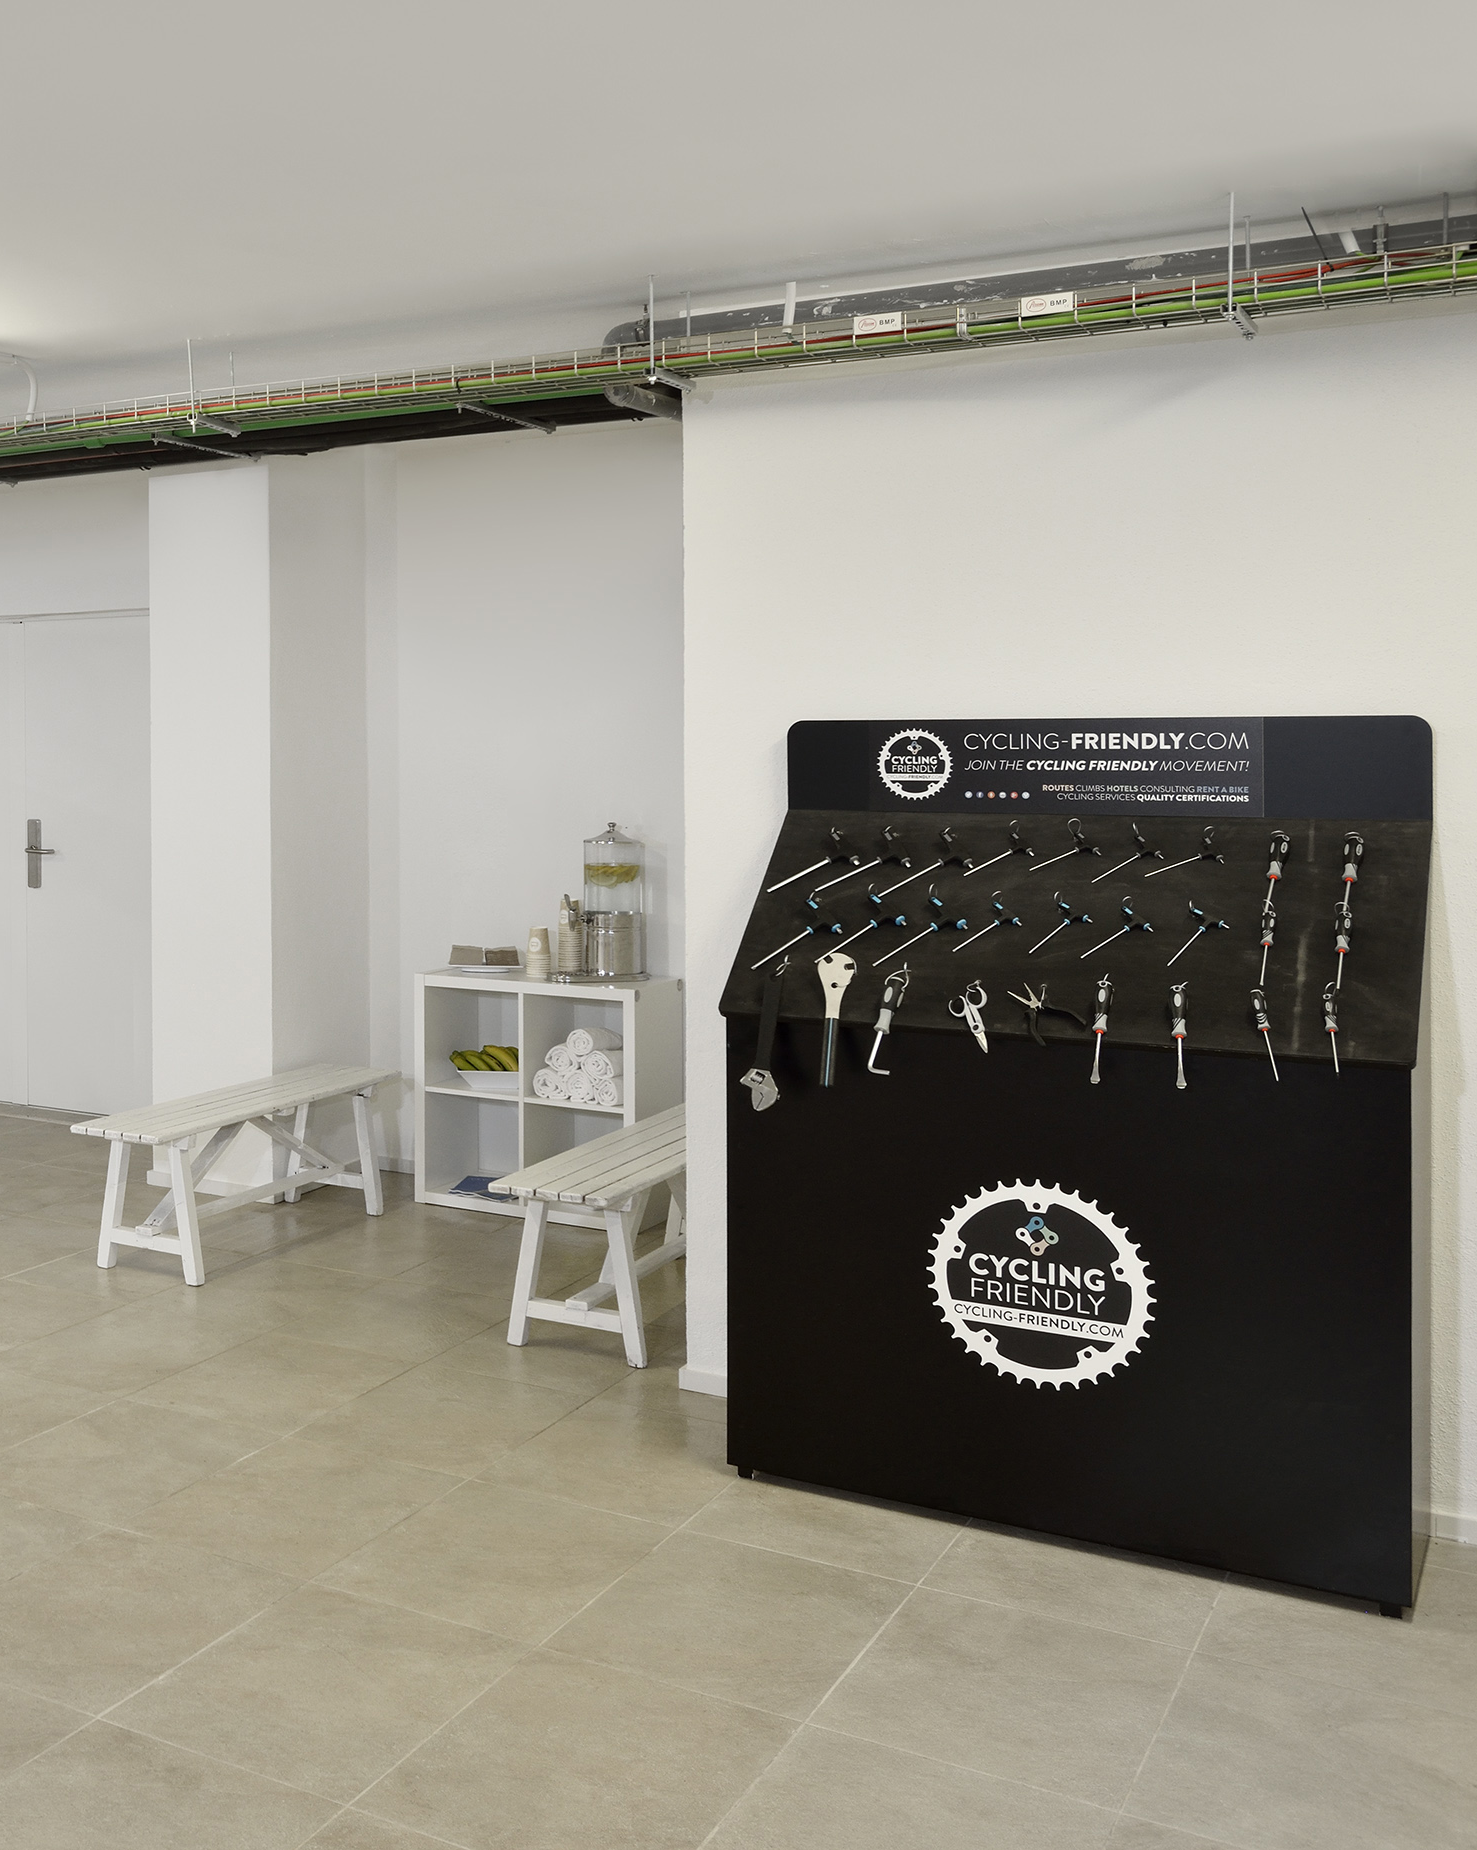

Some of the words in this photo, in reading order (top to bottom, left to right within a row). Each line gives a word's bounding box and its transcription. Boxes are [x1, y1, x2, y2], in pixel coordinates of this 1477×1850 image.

[1049, 298, 1068, 307] BMP
[878, 318, 896, 326] BMP
[964, 732, 1249, 750] CYCLING-FRIENDLY.COM
[891, 755, 938, 765] CYCLING
[891, 764, 938, 773] FRIENDLY
[964, 760, 996, 771] JOIN
[999, 760, 1024, 771] THE
[1026, 760, 1086, 771] CYCLING
[1088, 760, 1158, 771] FRIENDLY
[1159, 760, 1250, 772] MOVEMENT!
[1042, 784, 1074, 792] ROUTES
[1075, 784, 1105, 792] CLIMBS
[1056, 792, 1094, 800] CYCLING
[1095, 793, 1136, 801] SERVICES
[1136, 794, 1174, 803] QUALITY
[1175, 794, 1250, 802] CERTIFICATIONS
[968, 1252, 1106, 1292] CYCLING
[970, 1278, 1106, 1316] FRIENDLY
[954, 1303, 1124, 1339] CYCLING-FRIENDLY.COM
